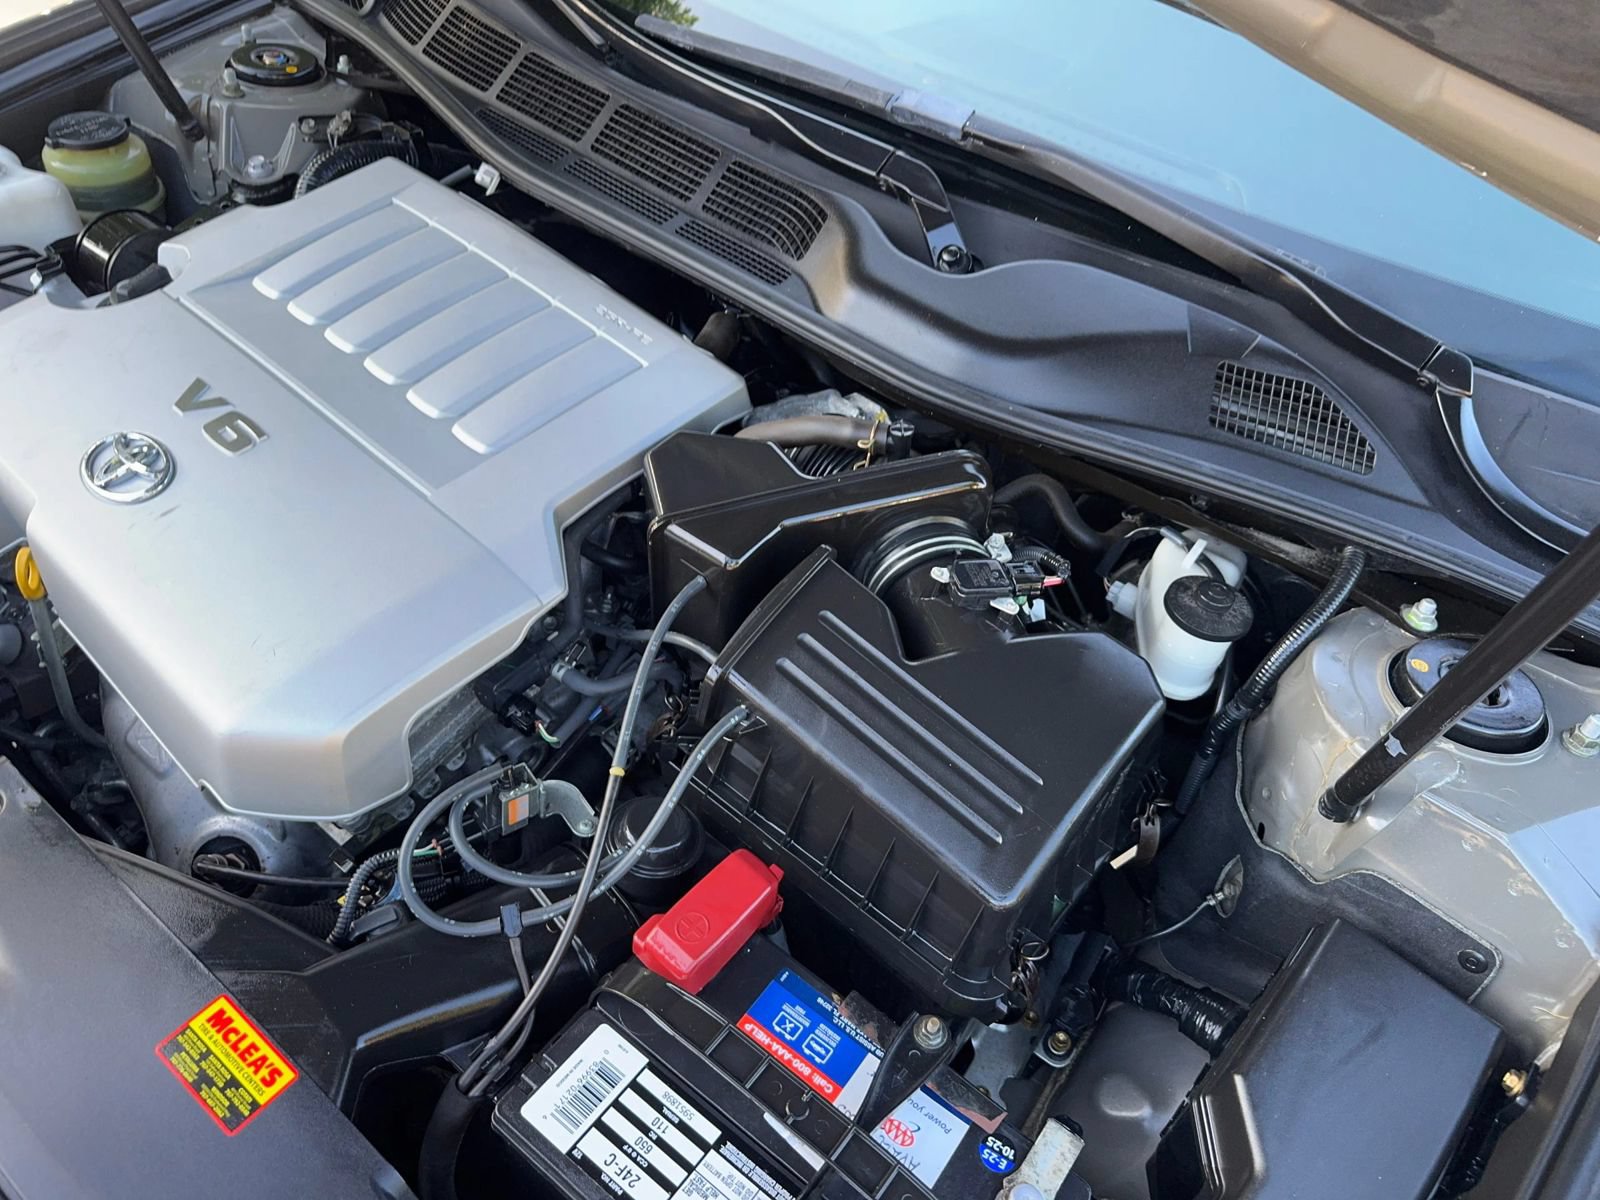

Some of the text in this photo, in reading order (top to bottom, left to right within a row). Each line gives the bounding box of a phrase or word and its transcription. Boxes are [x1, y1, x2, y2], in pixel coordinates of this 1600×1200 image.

[172, 376, 269, 456] V6
[844, 1025, 856, 1036] U.S.
[743, 1020, 811, 1076] 800-AAA-HELP
[854, 1032, 877, 1051] ASSIST
[197, 1022, 211, 1036] TIRE
[211, 1037, 244, 1073] AUTOMOTIVE
[241, 1070, 265, 1097] CENTERS
[810, 1072, 834, 1094] Call:
[660, 1105, 679, 1123] SERIAL
[661, 1089, 695, 1121] 5951898
[650, 1115, 670, 1134] 110
[906, 1097, 952, 1135] Power you
[648, 1129, 657, 1140] RC
[881, 1116, 914, 1147] AAA
[571, 1147, 583, 1160] 12V
[633, 1134, 653, 1155] 650
[986, 1136, 1015, 1160] 10-25
[635, 1154, 648, 1167] CCA
[982, 1150, 1008, 1170] E-25
[604, 1153, 642, 1188] 24F-C
[600, 1172, 624, 1195] PART NO.
[681, 1184, 693, 1197] GET
[720, 1175, 734, 1188] OPEN
[731, 1185, 743, 1196] NOT
[735, 1179, 746, 1191] NOT
[705, 1184, 719, 1199] HELP
